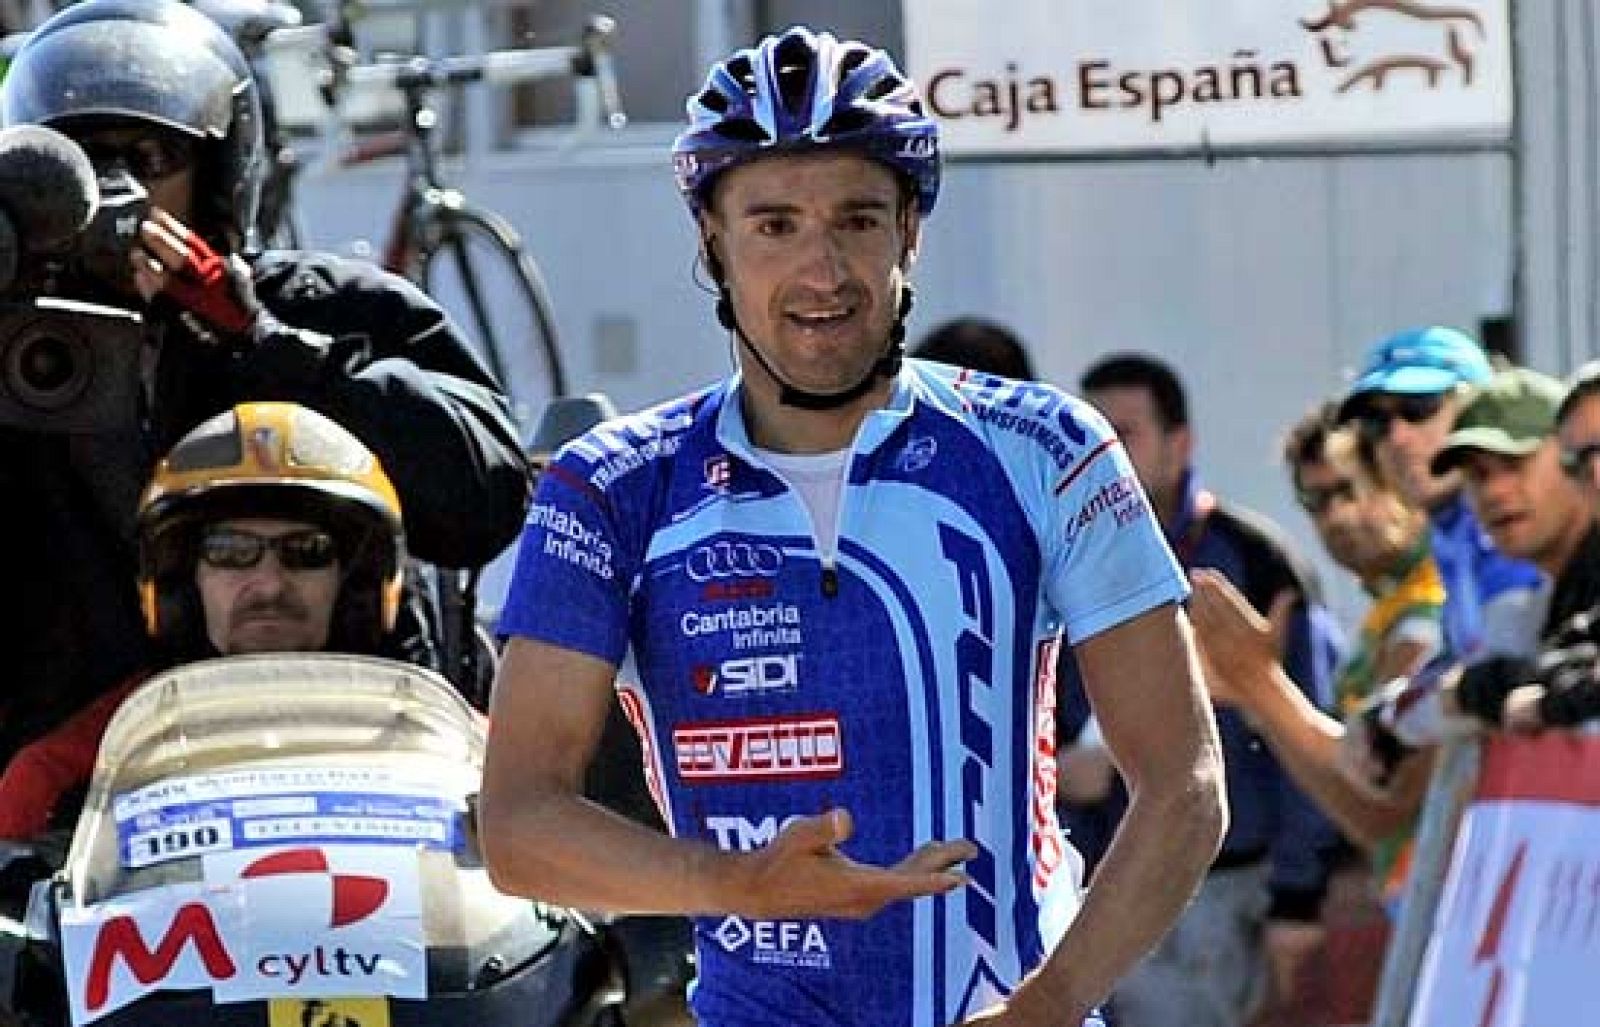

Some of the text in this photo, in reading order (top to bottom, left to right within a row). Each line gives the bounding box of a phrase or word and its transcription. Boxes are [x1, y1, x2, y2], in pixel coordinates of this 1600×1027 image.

[927, 50, 1303, 131] Caja España
[680, 601, 801, 637] Cantabria
[732, 627, 801, 650] Infinita
[721, 654, 799, 691] SIDI
[754, 920, 829, 952] EFA
[258, 945, 382, 984] cyltv
